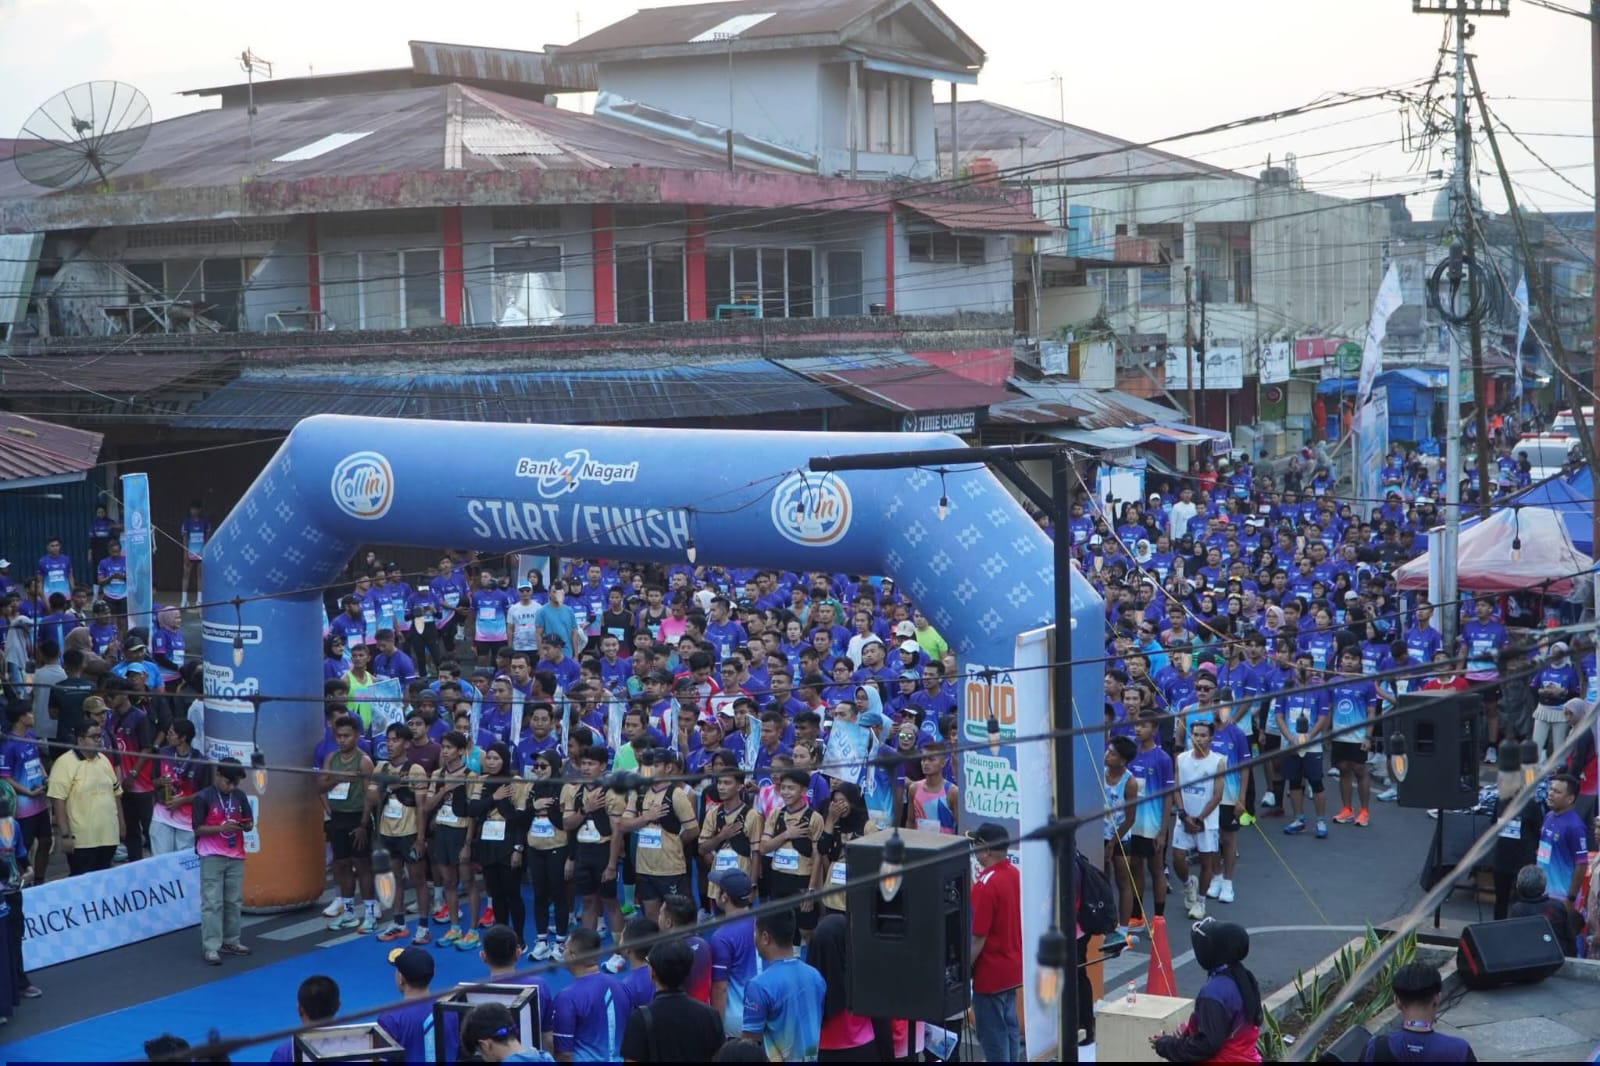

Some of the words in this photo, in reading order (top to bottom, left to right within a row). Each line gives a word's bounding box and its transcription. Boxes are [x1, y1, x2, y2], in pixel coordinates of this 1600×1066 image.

[918, 415, 940, 431] TIME
[941, 412, 975, 429] CORNER
[518, 460, 558, 476] Bank
[582, 463, 636, 482] Nagari
[467, 500, 565, 543] START
[583, 505, 691, 550] FINISH
[966, 755, 1006, 771] Tabungan
[966, 768, 1018, 792] TAHA
[20, 905, 80, 941] RICK
[83, 879, 185, 924] HAMDANI
